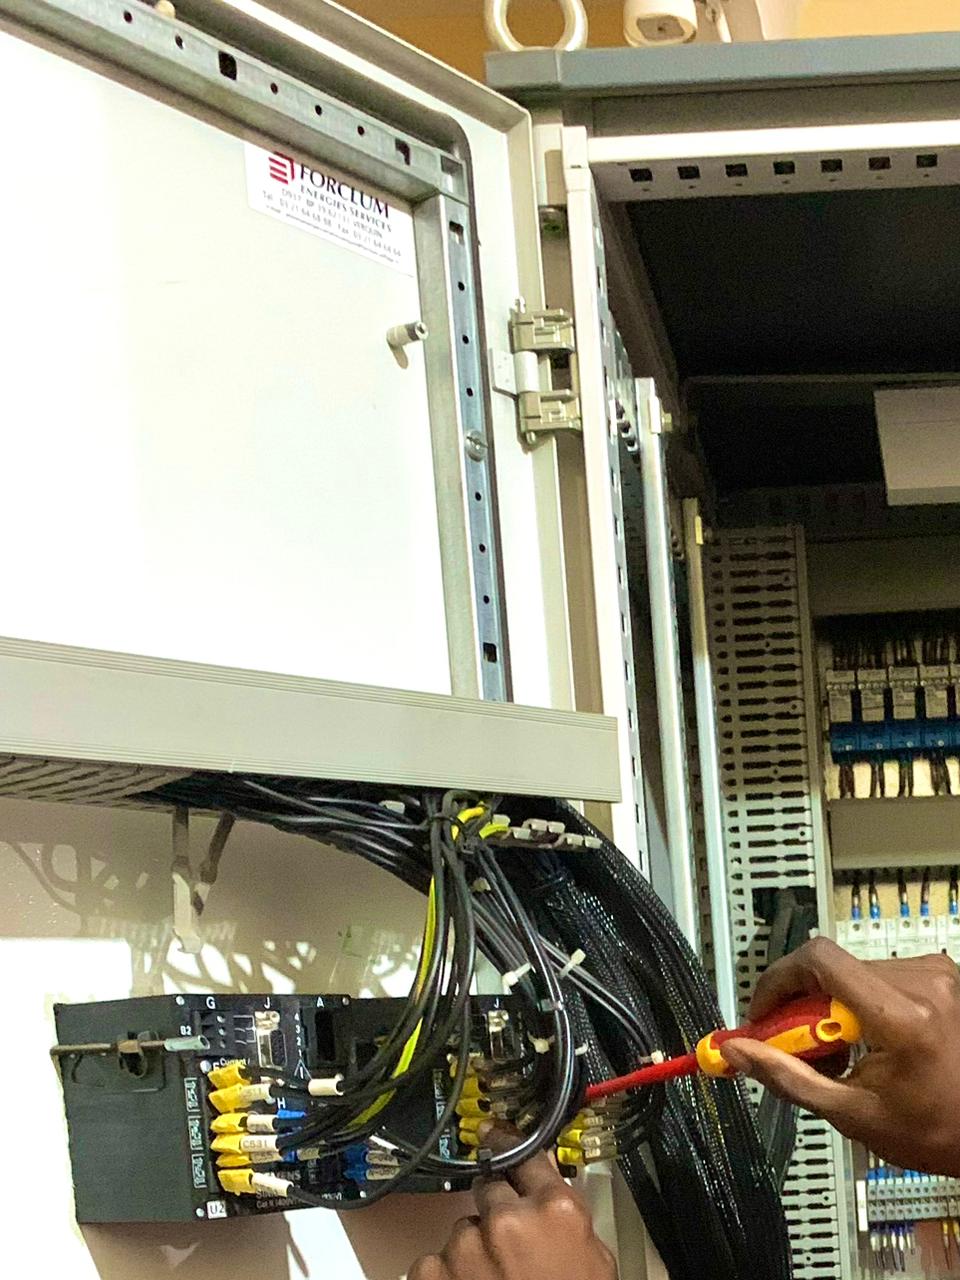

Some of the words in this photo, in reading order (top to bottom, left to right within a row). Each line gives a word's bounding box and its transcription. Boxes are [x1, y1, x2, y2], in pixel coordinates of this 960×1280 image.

[300, 163, 390, 219] FORCLUM
[300, 184, 348, 213] ENERGIES
[349, 206, 392, 233] SERVICES
[206, 997, 216, 1010] G
[264, 997, 271, 1009] J
[316, 998, 324, 1008] A
[277, 1097, 286, 1109] H
[210, 1203, 225, 1215] U2
